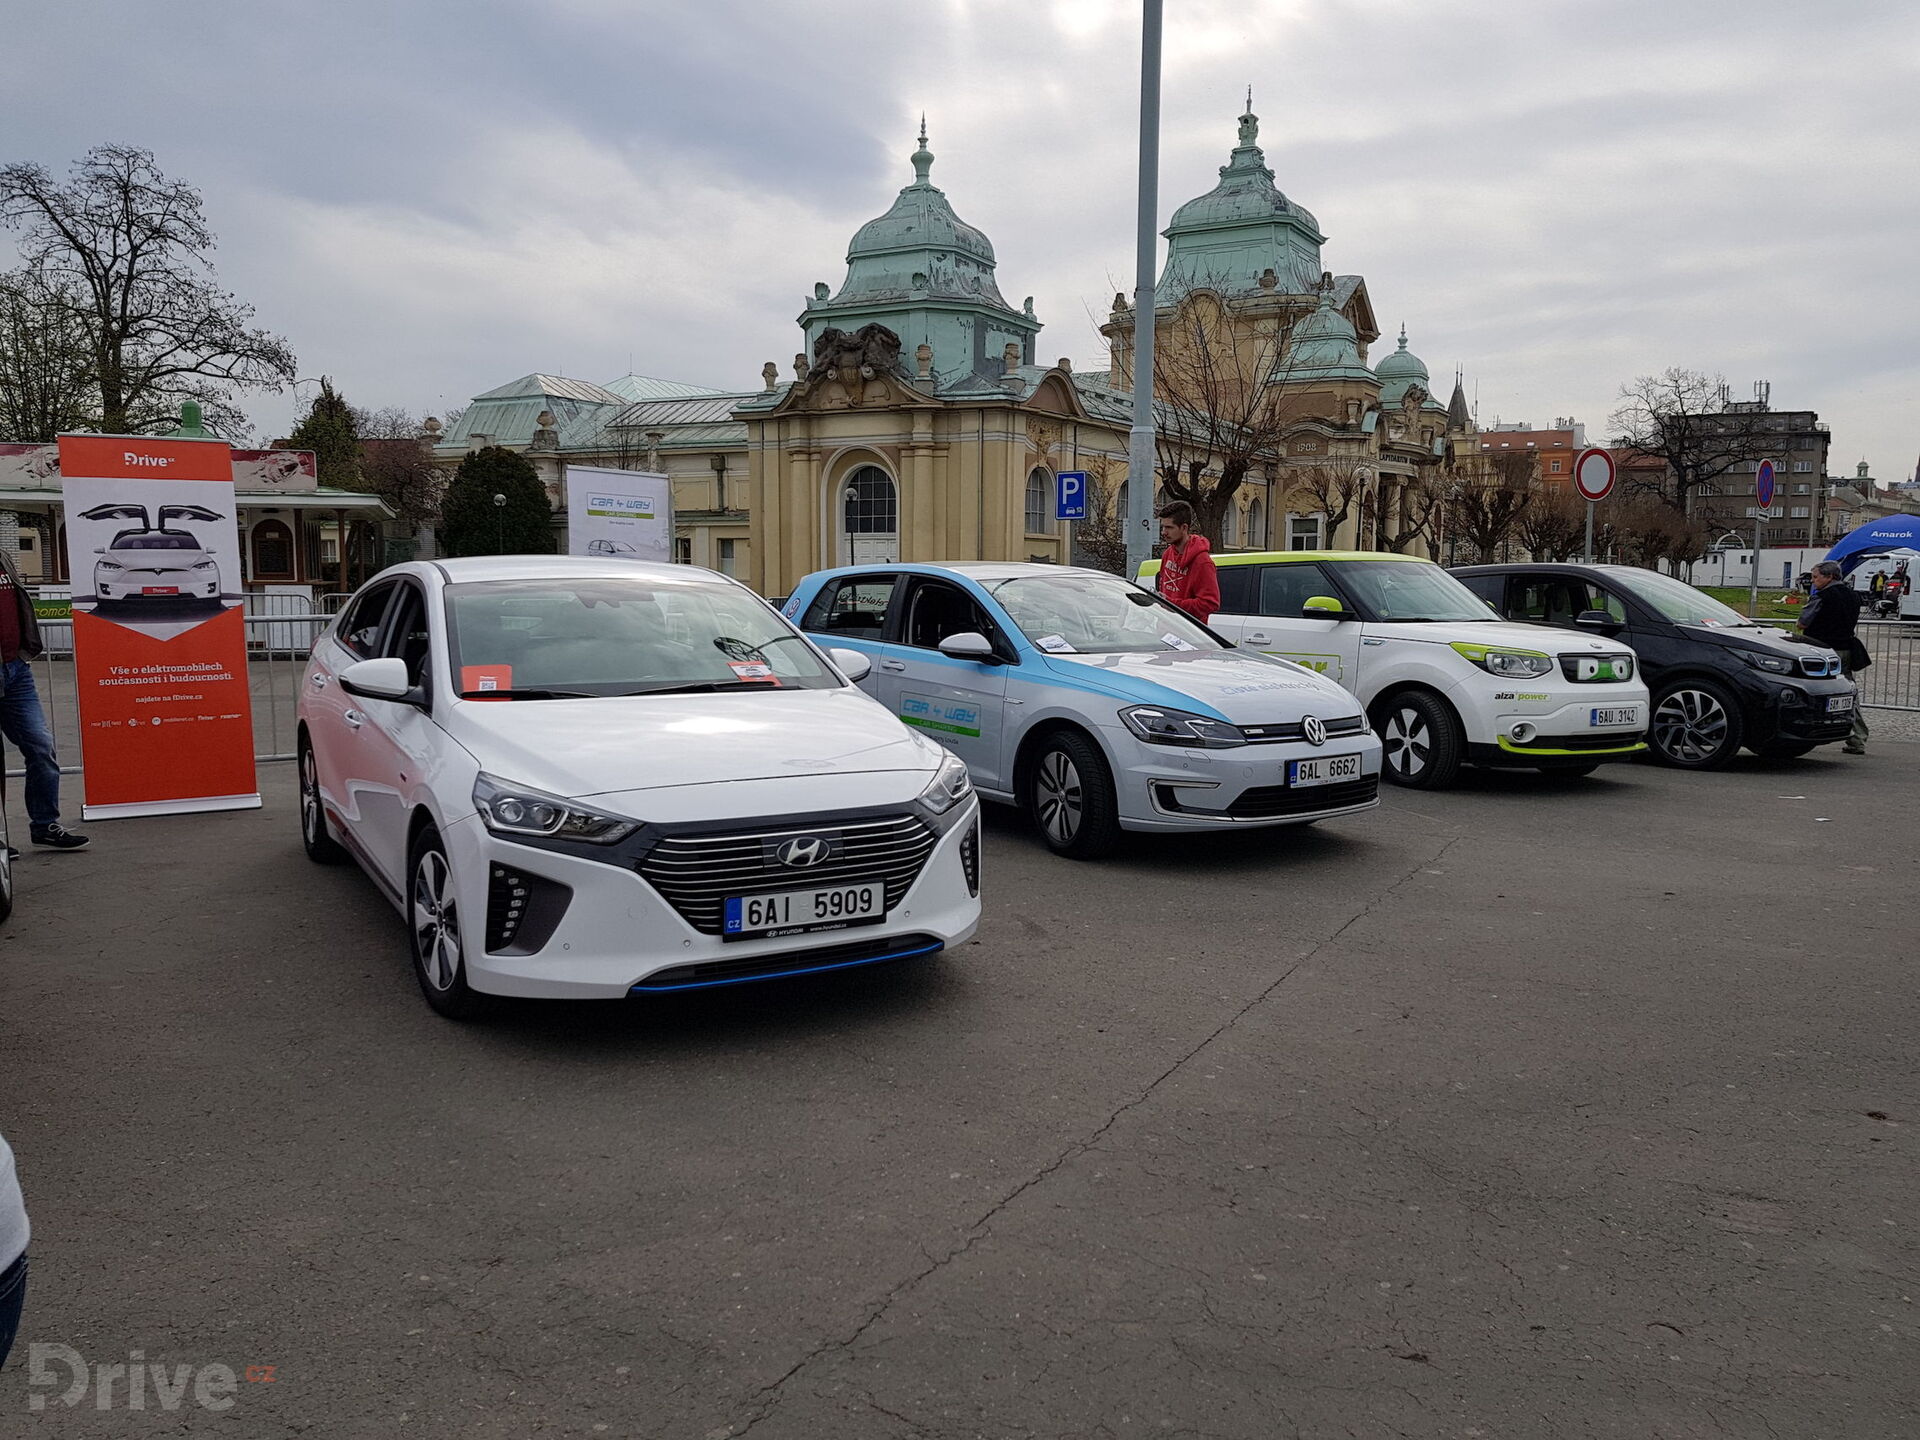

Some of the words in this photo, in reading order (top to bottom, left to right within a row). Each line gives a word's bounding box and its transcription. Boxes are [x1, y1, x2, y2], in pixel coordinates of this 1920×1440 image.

[1296, 443, 1317, 452] 1908
[1062, 478, 1080, 505] P
[110, 665, 130, 675] Vše
[141, 662, 223, 674] elektromobilech
[99, 674, 162, 686] současnosti
[169, 671, 234, 683] budoucnosti.
[135, 696, 161, 704] najdete
[1494, 692, 1515, 700] alza
[1517, 692, 1548, 701] power
[933, 705, 942, 716] 4
[1598, 709, 1614, 724] 6AU
[1618, 708, 1635, 723] 3142
[1299, 762, 1321, 781] 6AL
[1329, 757, 1356, 777] 6662
[748, 896, 790, 926] 6AI
[814, 887, 873, 919] 5909
[727, 919, 741, 929] CZ
